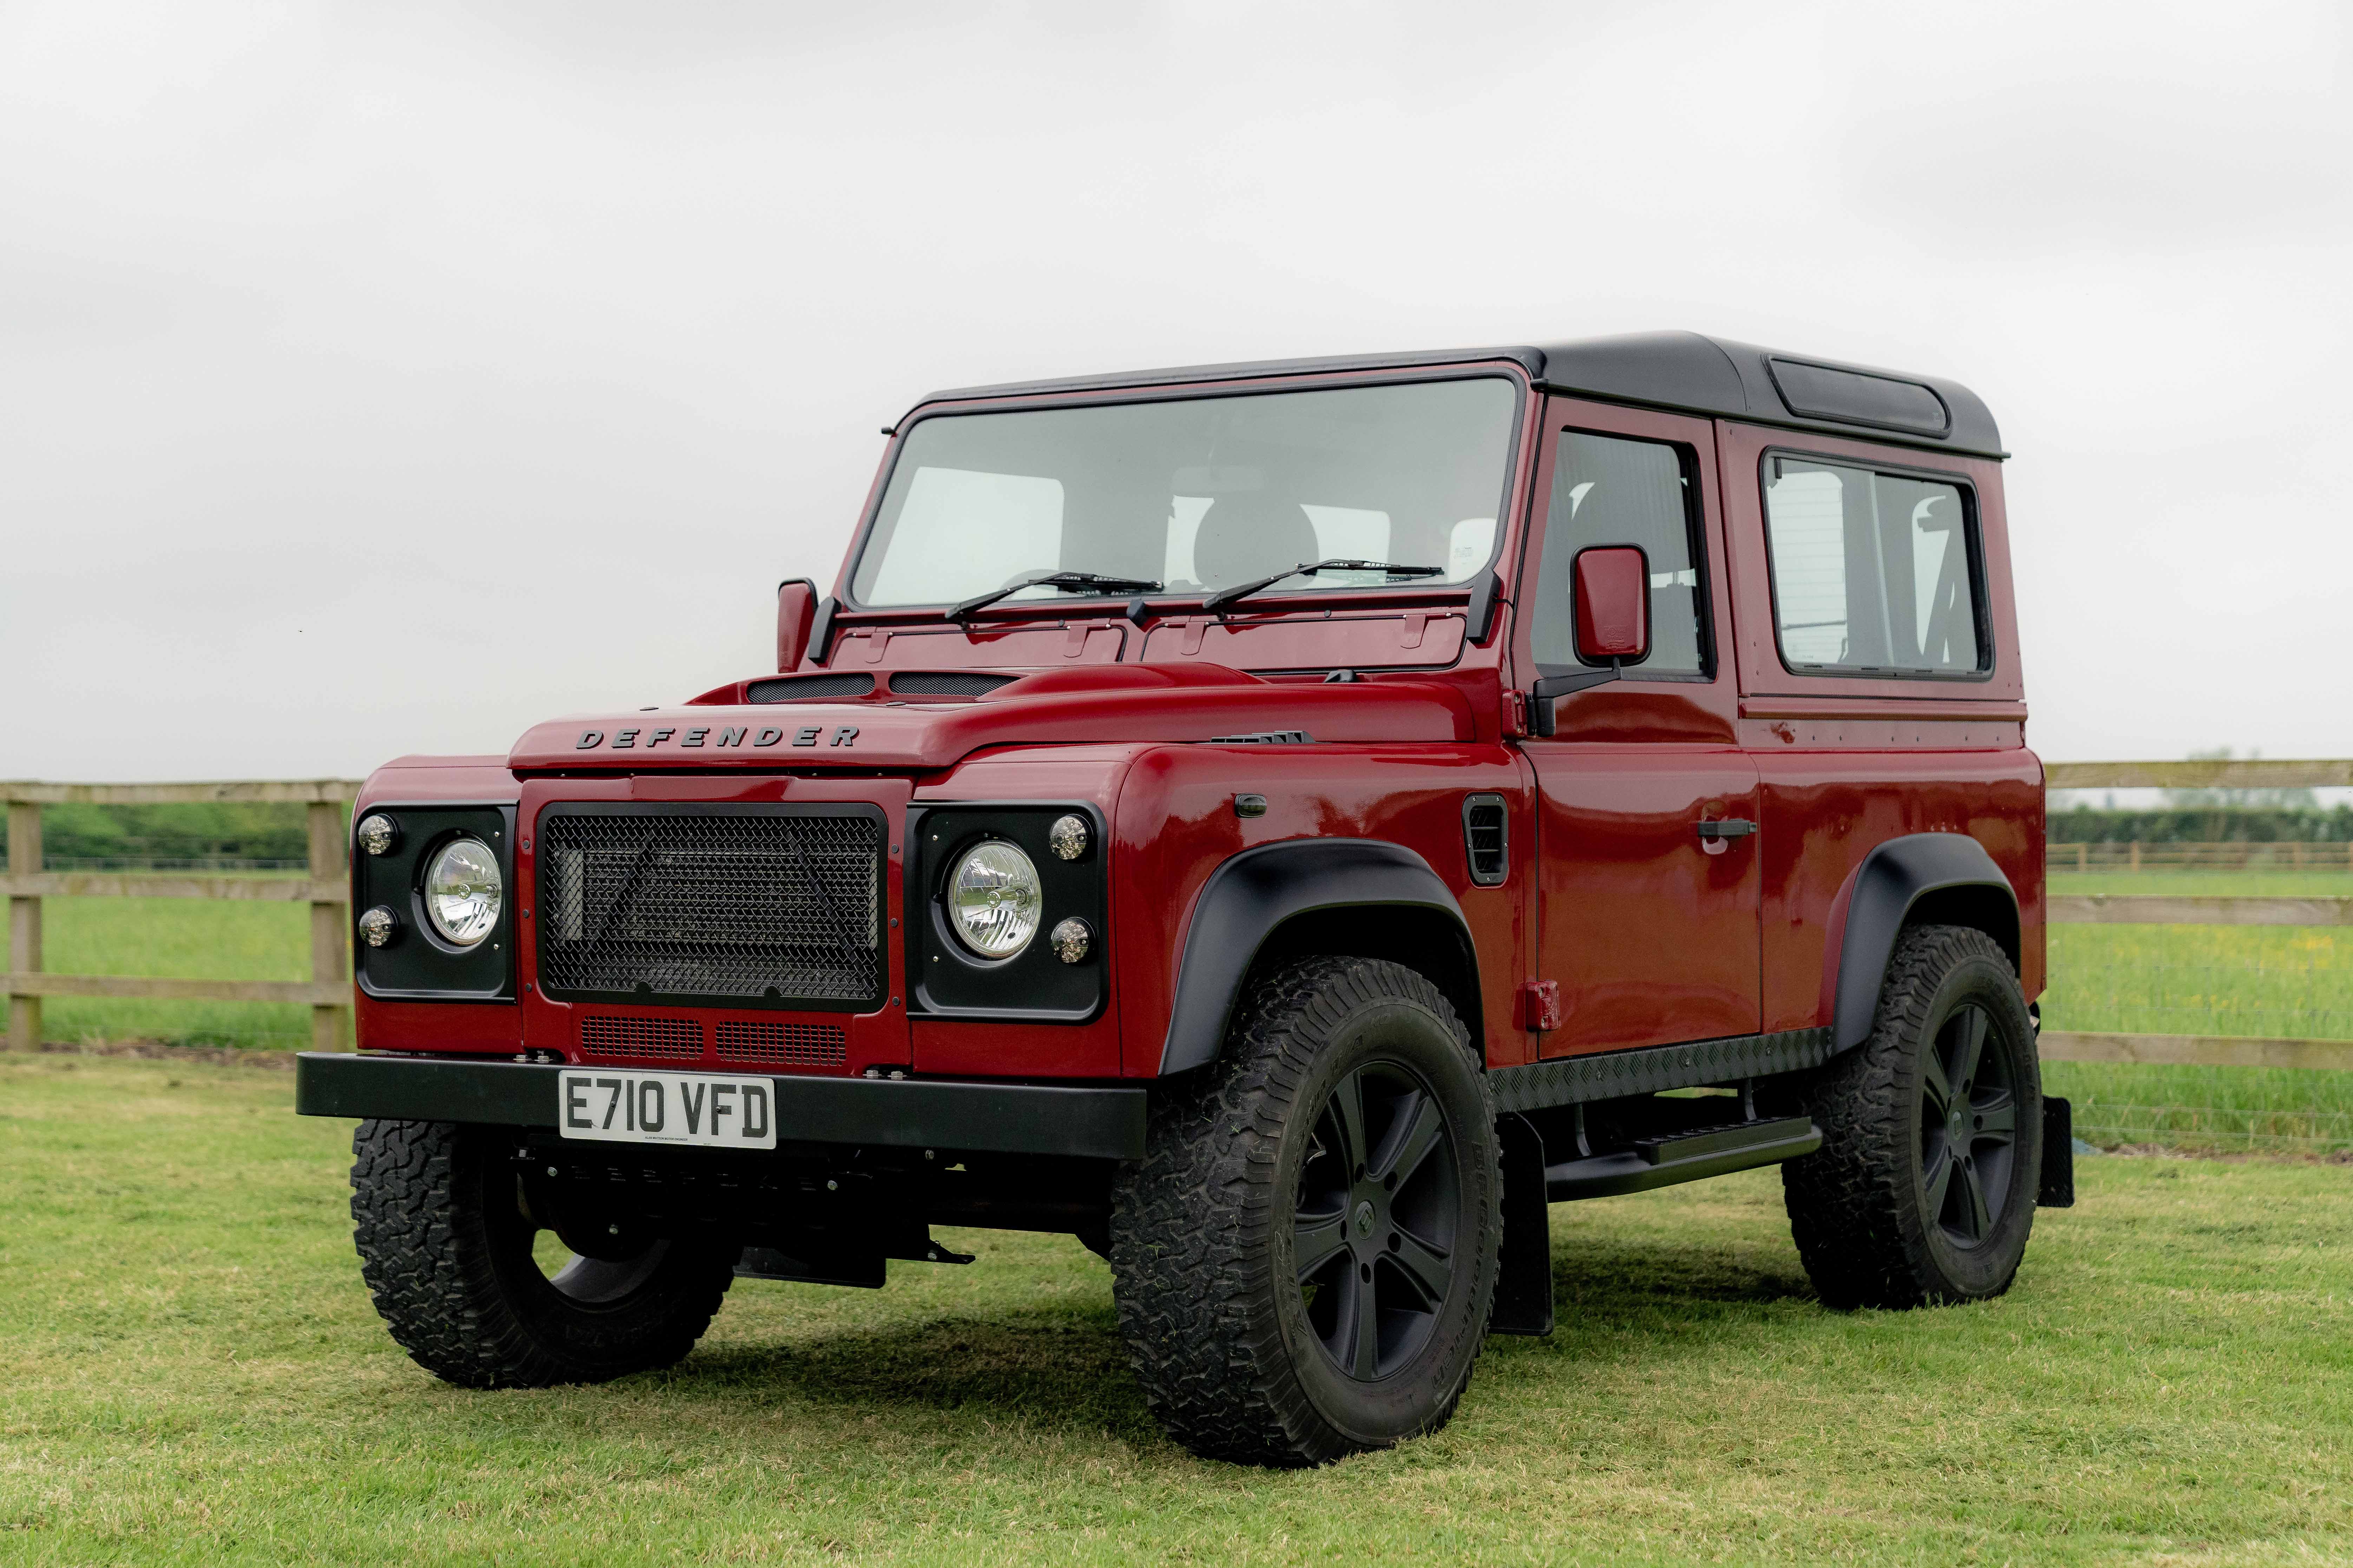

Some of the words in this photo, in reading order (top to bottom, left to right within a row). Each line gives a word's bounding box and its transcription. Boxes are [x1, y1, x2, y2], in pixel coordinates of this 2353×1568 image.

[576, 726, 859, 749] DEFENDER
[566, 1077, 664, 1132] E710
[680, 1082, 768, 1139] VFD
[1431, 1141, 1488, 1389] BFGoodrich
